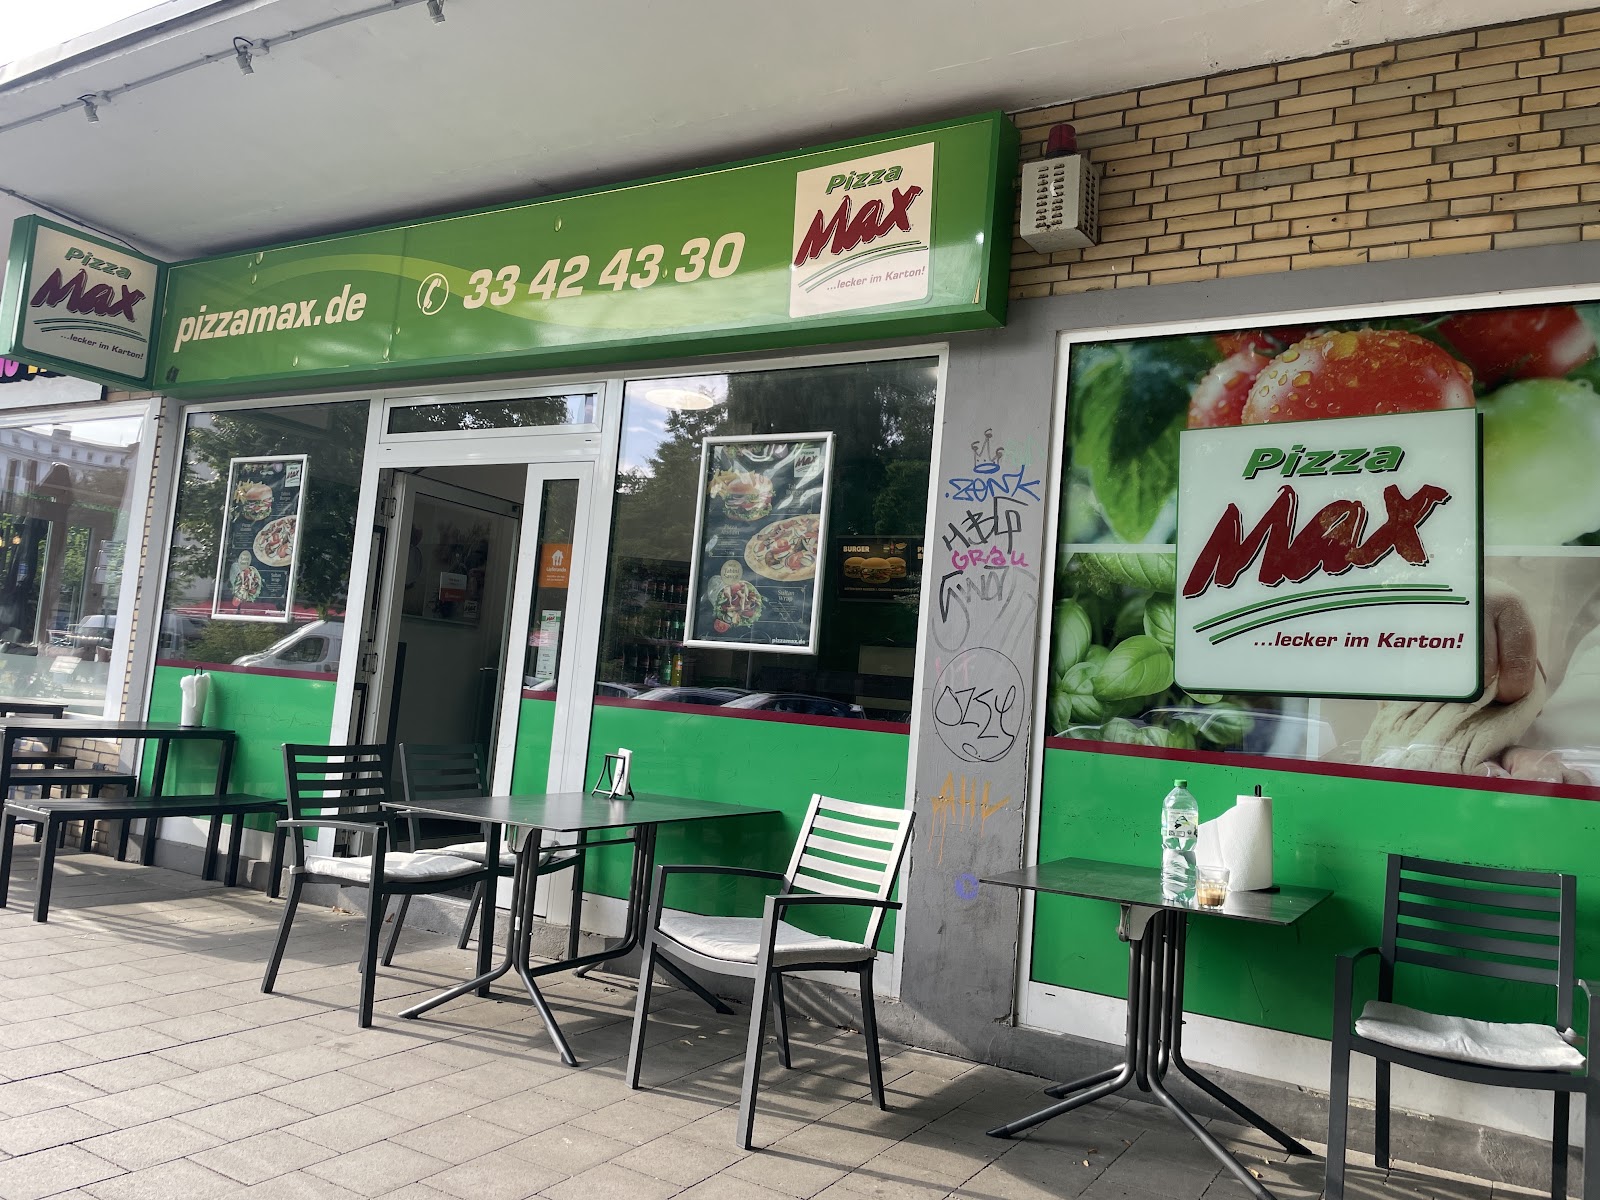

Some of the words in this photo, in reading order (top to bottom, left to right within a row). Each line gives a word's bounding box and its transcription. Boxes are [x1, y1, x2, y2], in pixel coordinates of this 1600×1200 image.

[825, 163, 904, 195] Pizza
[795, 184, 923, 269] Max
[64, 246, 133, 281] Pizza
[463, 265, 521, 310] 33
[528, 255, 590, 301] 42
[598, 243, 664, 292] 43
[674, 231, 746, 284] 30
[870, 273, 883, 285] im
[885, 265, 926, 283] Karton!
[30, 267, 147, 324] Max
[172, 283, 367, 354] pizzamax.de
[98, 340, 110, 351] im
[111, 344, 145, 361] Karton!
[1242, 444, 1405, 480] Pizza
[843, 545, 870, 553] BURGER
[1182, 483, 1453, 600] Max
[772, 637, 806, 645] pizzamax.de
[1254, 631, 1338, 648] ...lecker
[1344, 632, 1370, 648] im
[1377, 631, 1464, 649] Karton!
